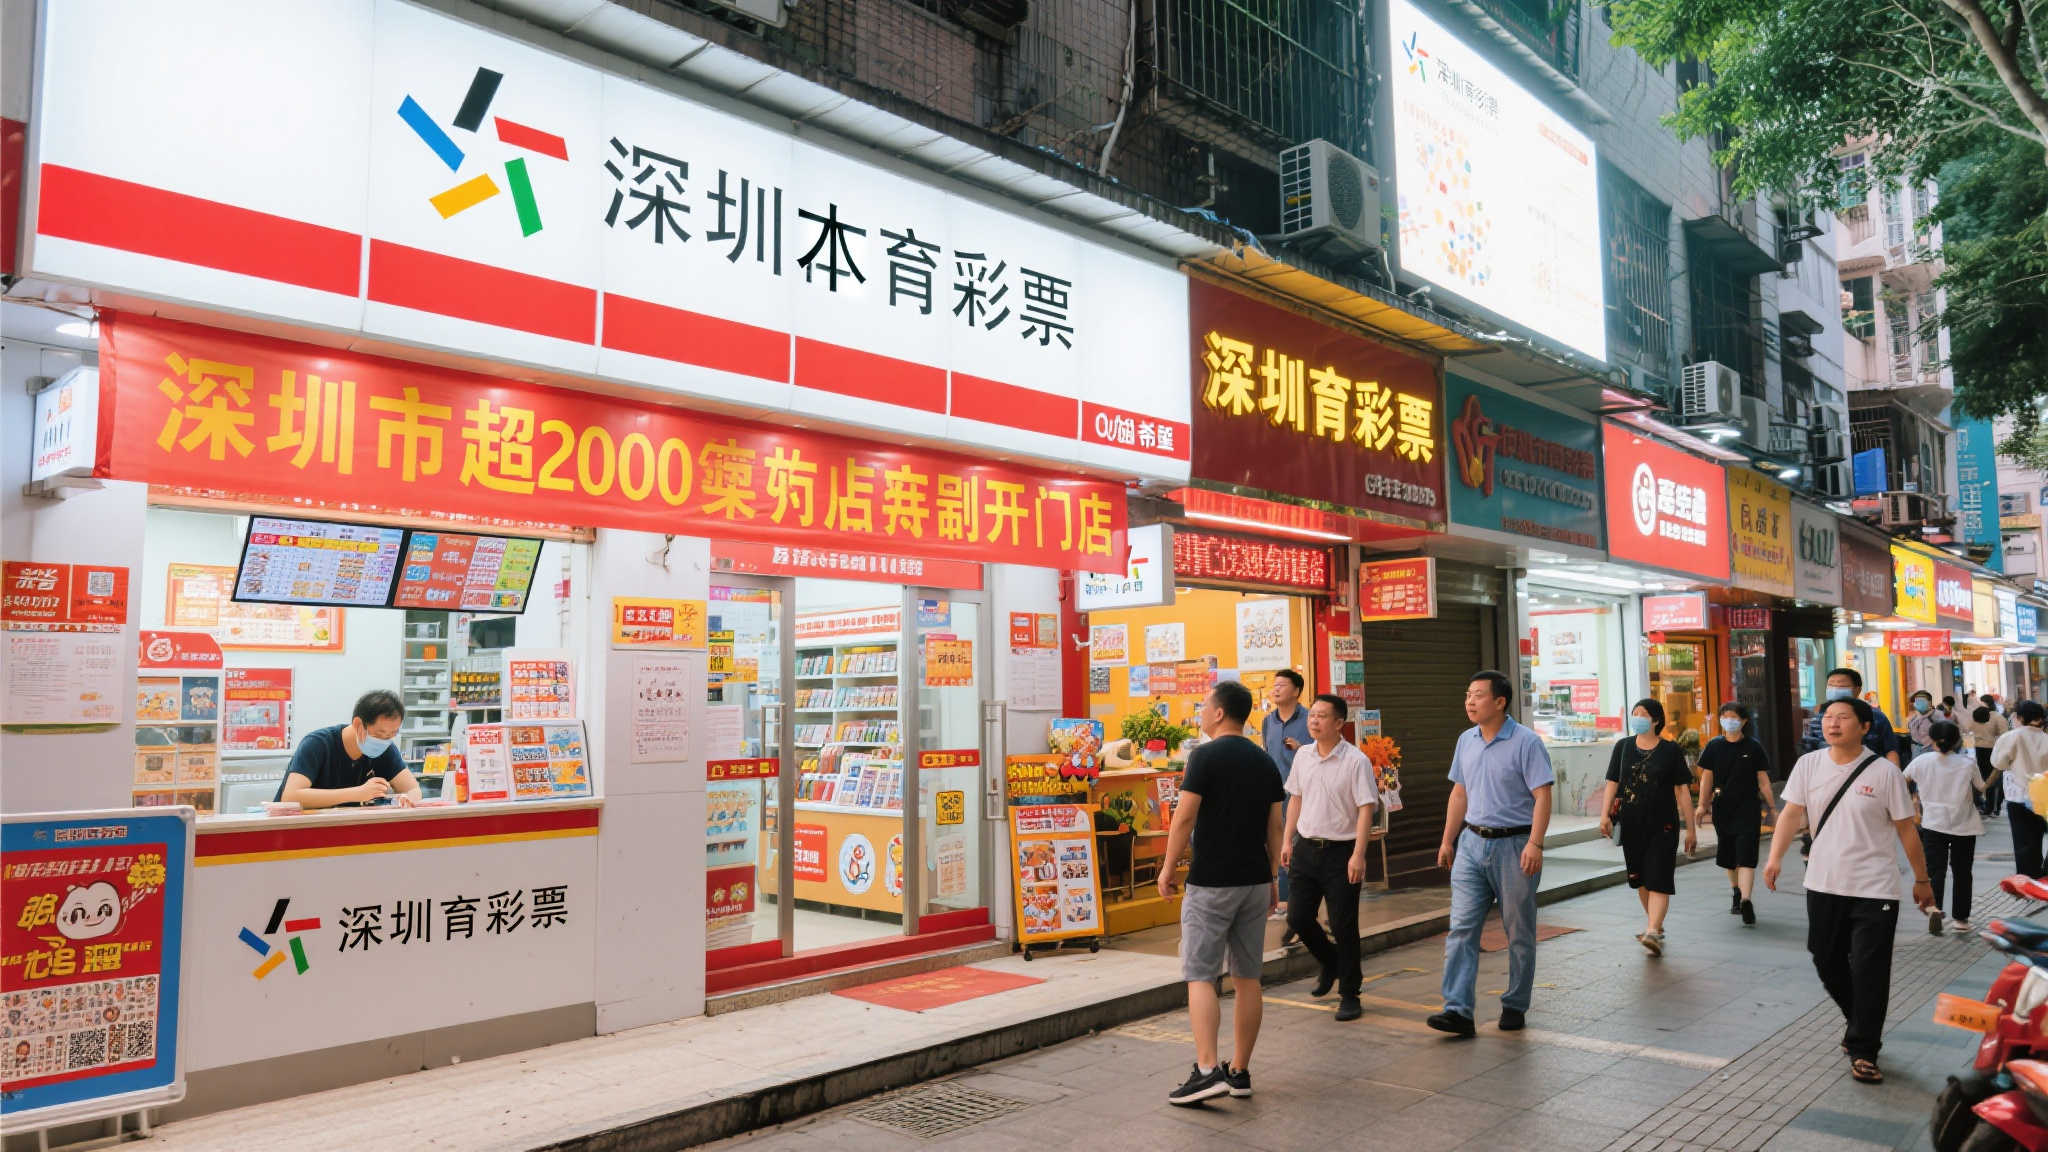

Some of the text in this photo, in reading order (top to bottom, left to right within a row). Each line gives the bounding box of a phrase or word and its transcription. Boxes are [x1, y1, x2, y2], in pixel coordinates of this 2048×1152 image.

[1203, 331, 1434, 464] 深圳育彩票
[338, 884, 569, 953] 深圳育彩票
